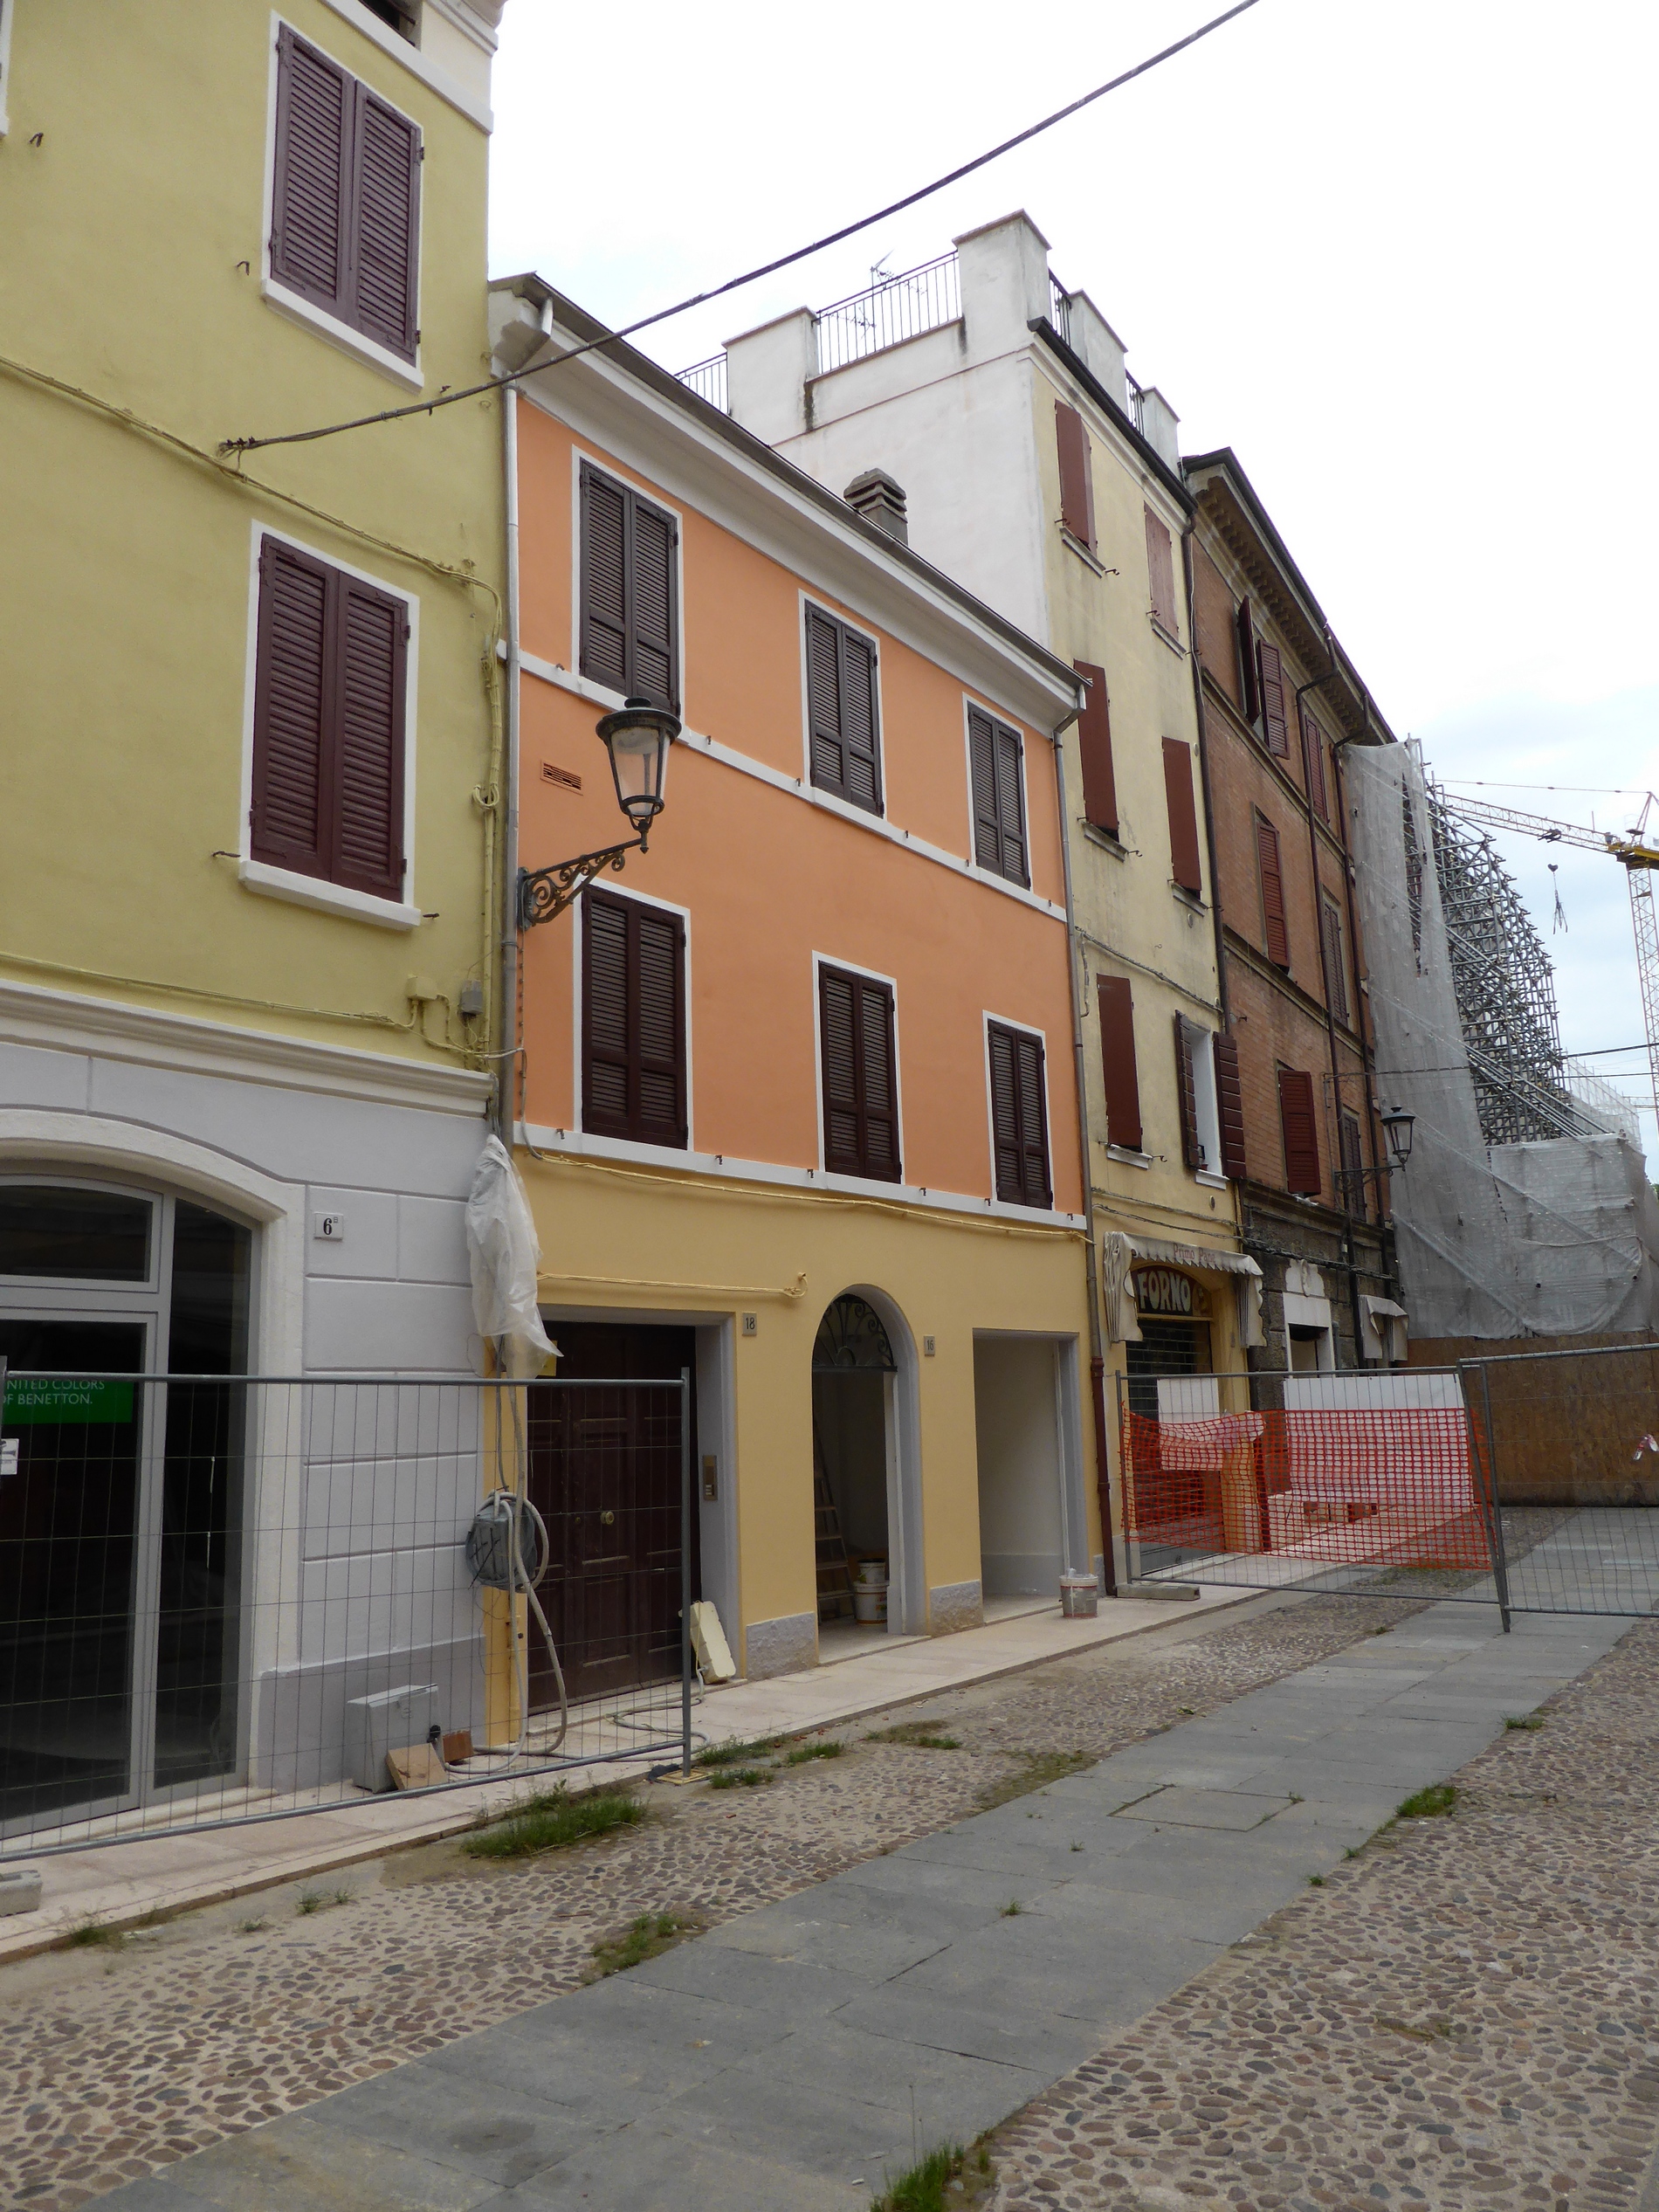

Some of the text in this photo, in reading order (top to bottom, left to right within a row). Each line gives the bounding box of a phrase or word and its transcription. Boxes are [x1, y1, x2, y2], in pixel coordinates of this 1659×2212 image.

[1173, 1243, 1195, 1260] Primo
[1137, 1270, 1191, 1313] FORNO
[746, 1317, 755, 1330] 18
[926, 1340, 934, 1351] 16
[5, 1379, 106, 1390] NITED COLORS
[17, 1393, 93, 1405] BENETTON.
